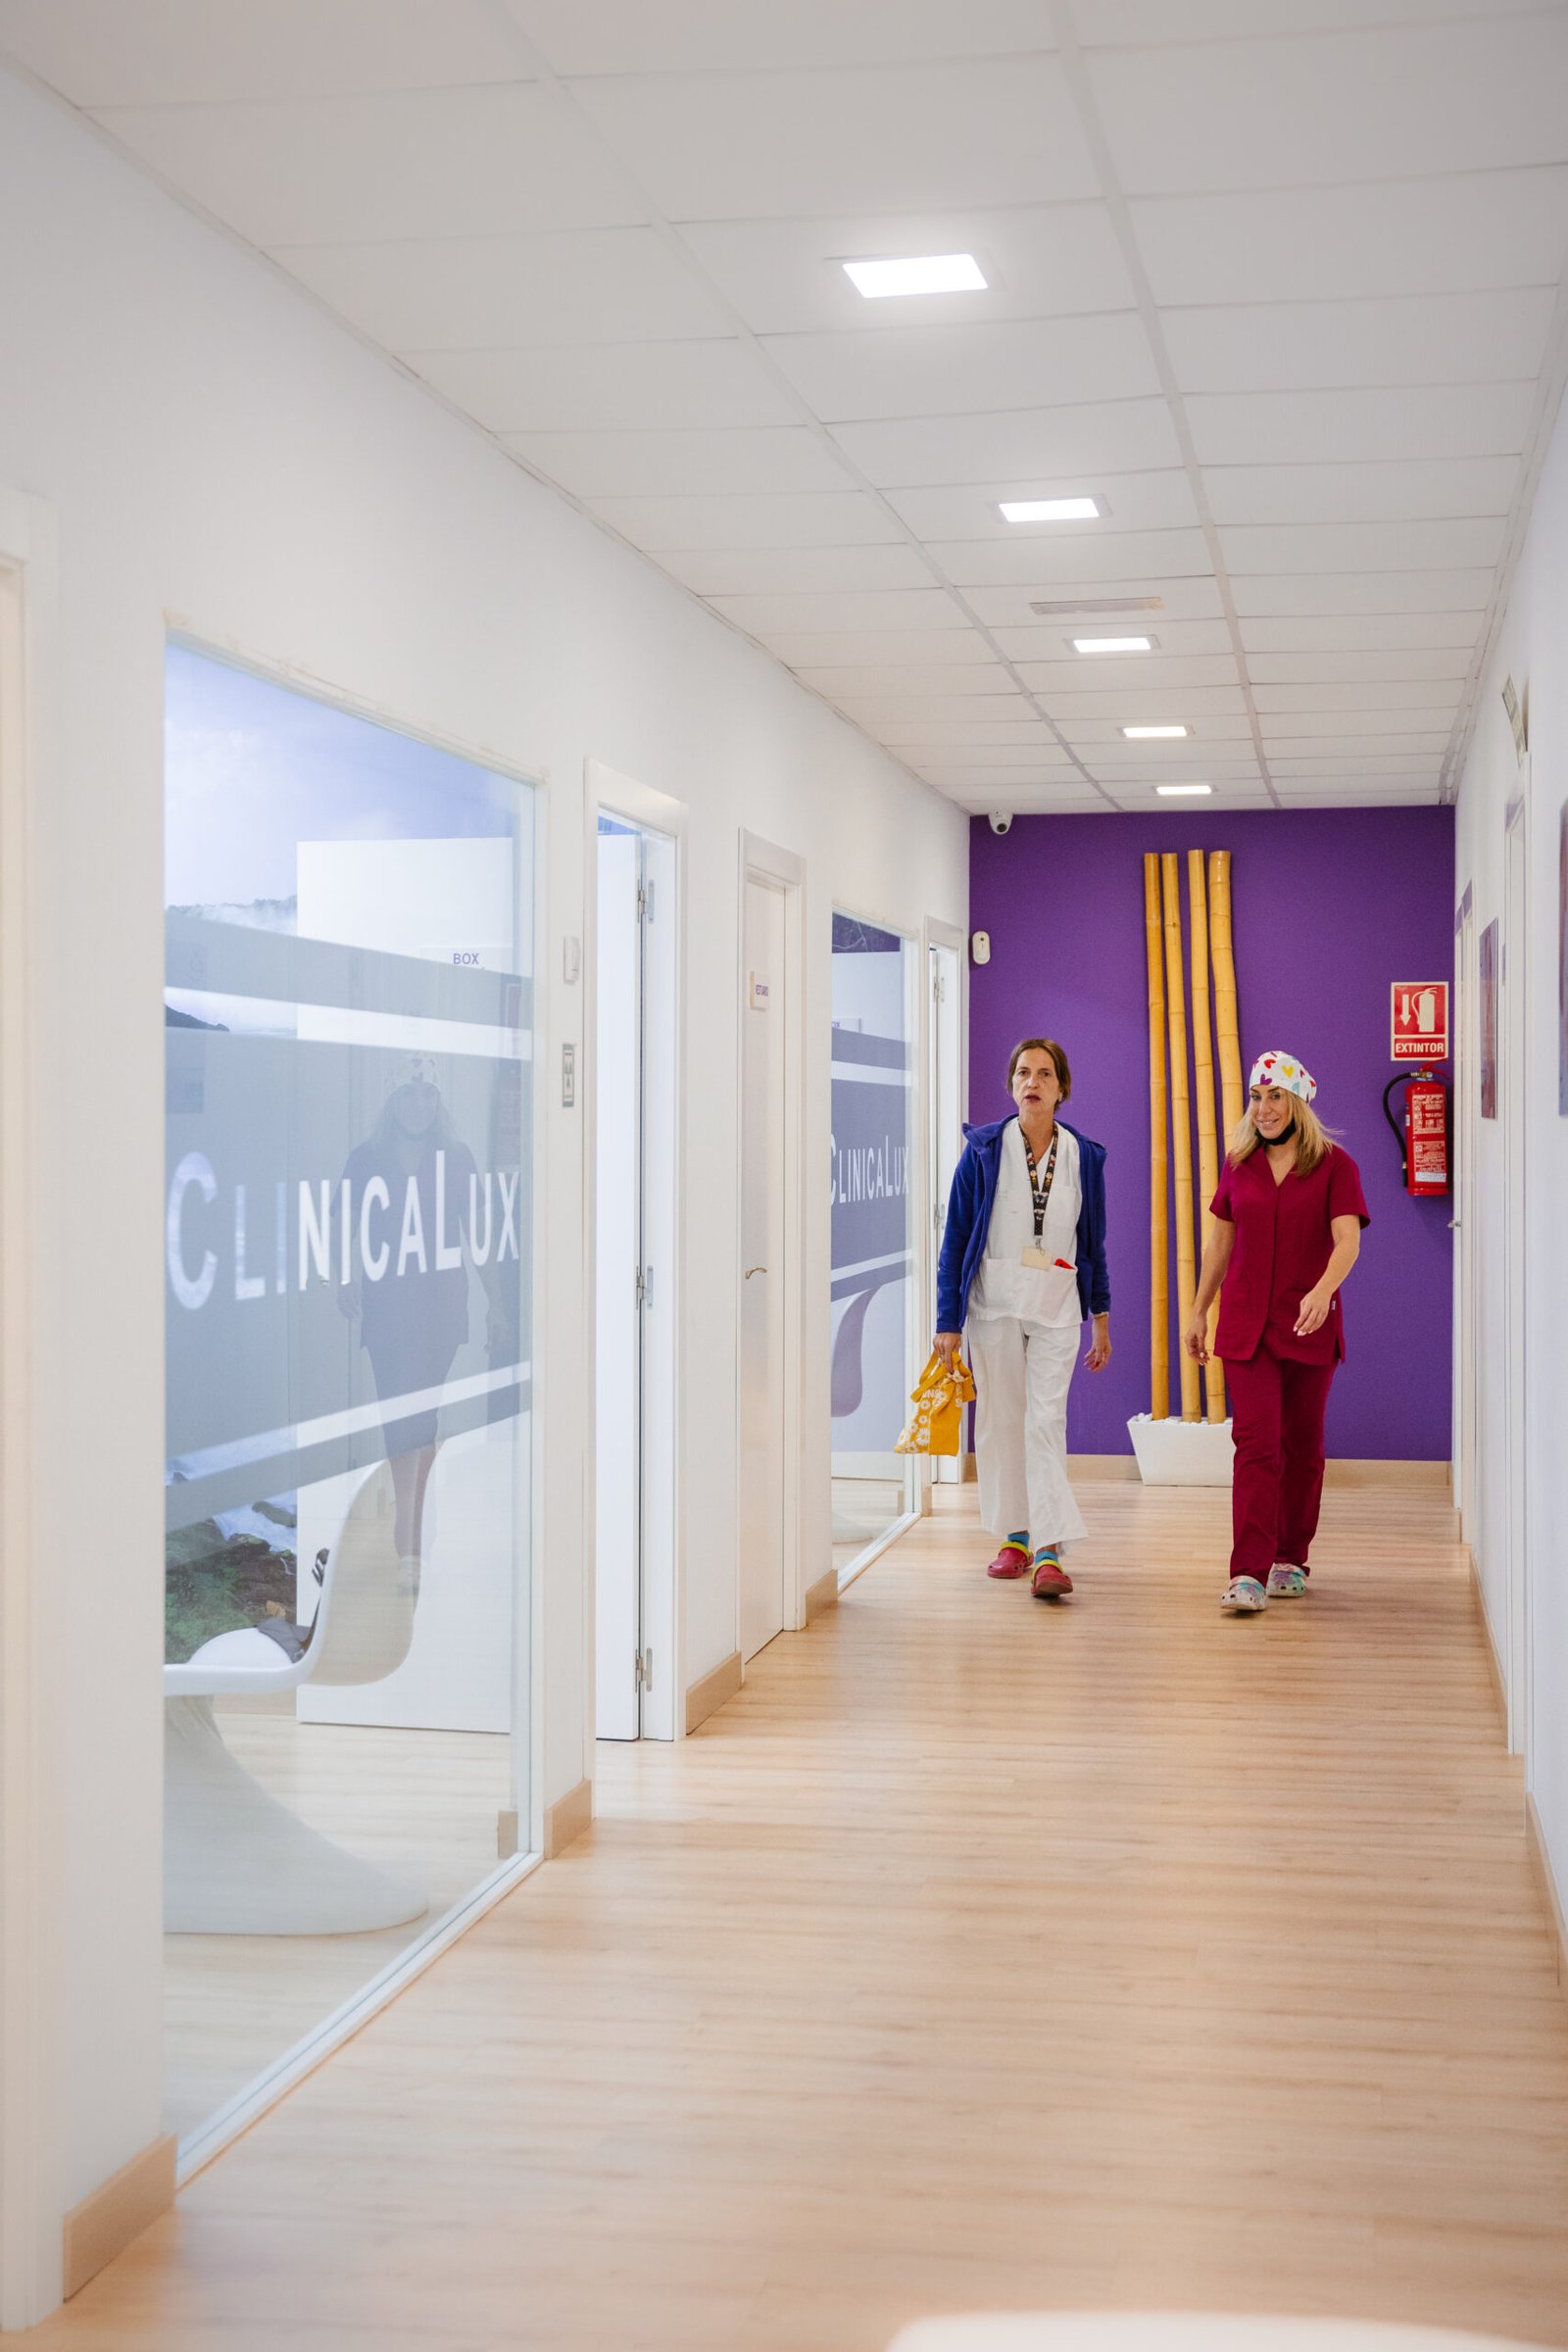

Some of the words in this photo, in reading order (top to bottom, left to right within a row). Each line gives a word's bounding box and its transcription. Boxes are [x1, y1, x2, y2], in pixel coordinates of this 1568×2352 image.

[453, 953, 479, 965] BOX
[1395, 1042, 1445, 1054] EXTINTOR
[167, 1151, 519, 1309] CLINICALUX
